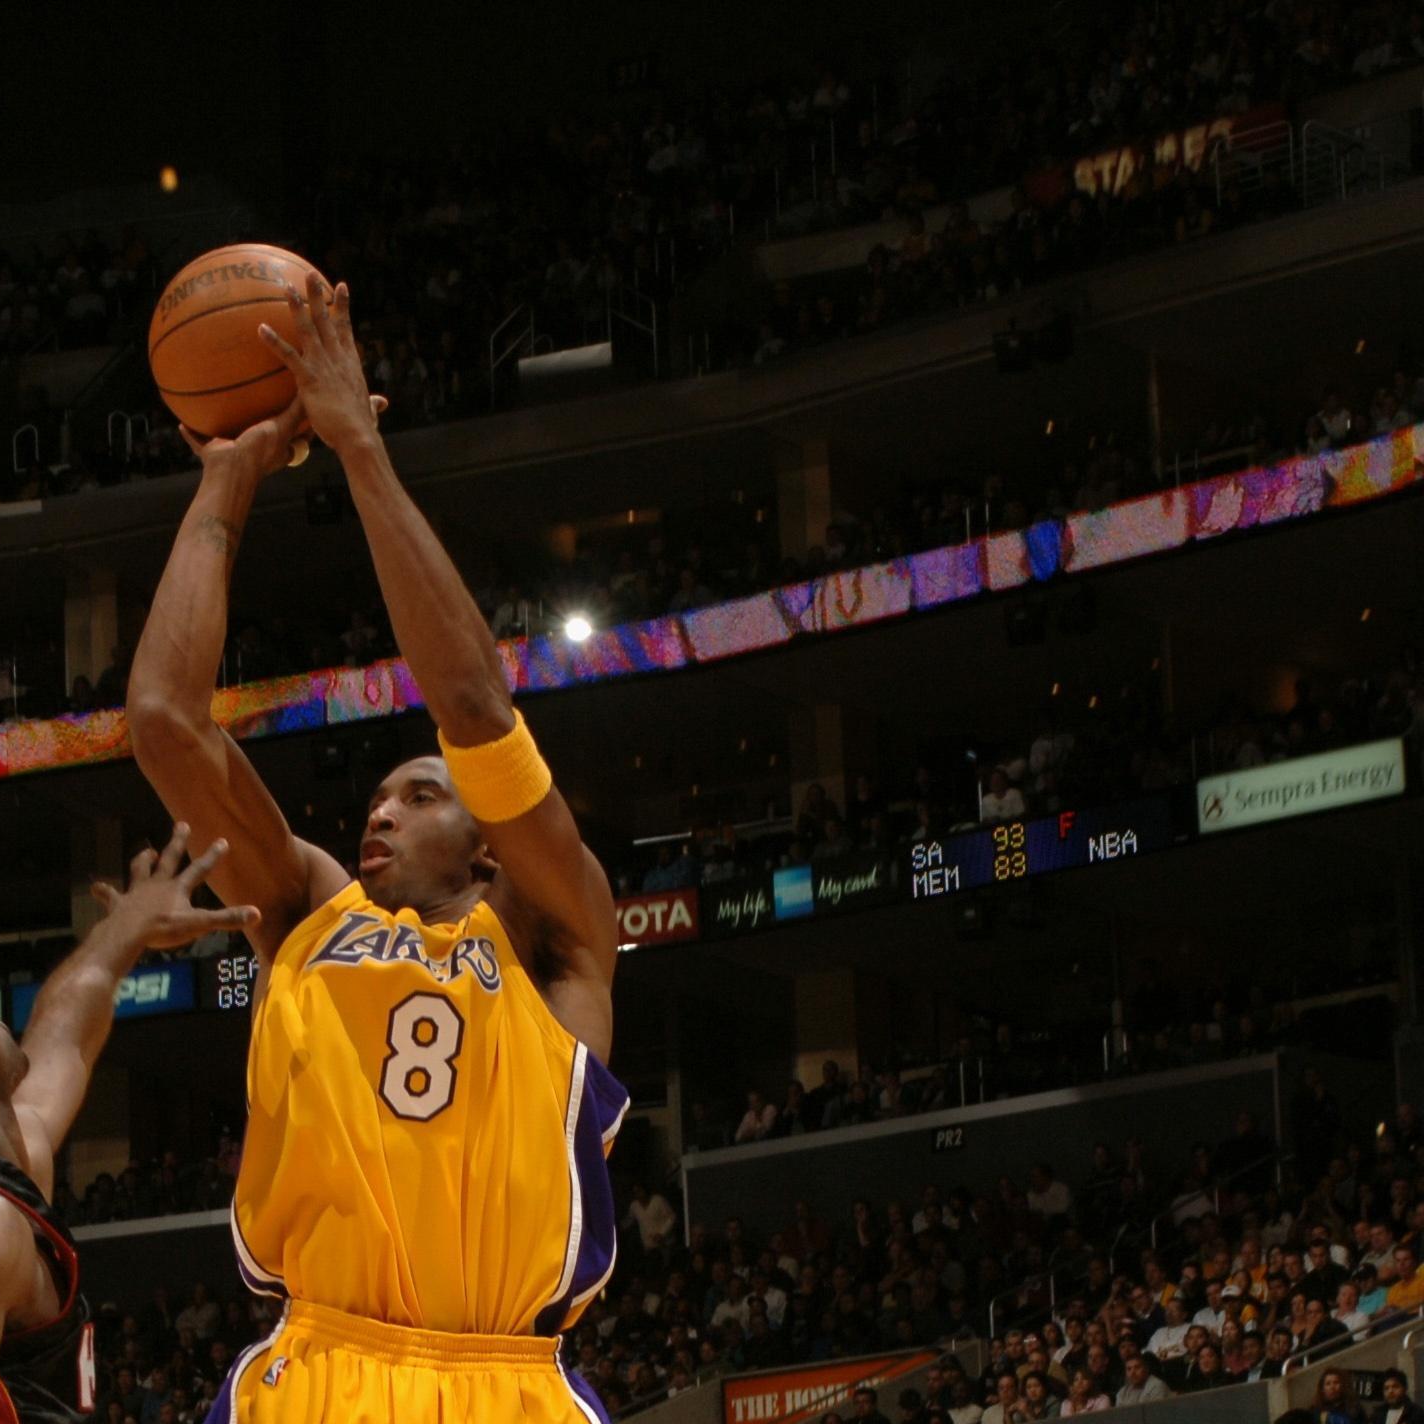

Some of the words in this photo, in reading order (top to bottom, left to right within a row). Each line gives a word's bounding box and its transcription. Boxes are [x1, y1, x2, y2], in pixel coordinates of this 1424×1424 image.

[1234, 781, 1316, 811] Sempra
[1321, 763, 1396, 794] Energy
[1059, 810, 1075, 838] F
[911, 841, 943, 870] SA
[1088, 829, 1138, 863] NBA
[912, 864, 960, 899] MEM
[615, 898, 694, 938] OTA
[308, 911, 502, 993] LAKRS
[113, 970, 171, 1006] PSI
[218, 984, 249, 1009] GS
[378, 989, 465, 1123] 8
[936, 1127, 963, 1150] PR2
[731, 1392, 780, 1423] THE
